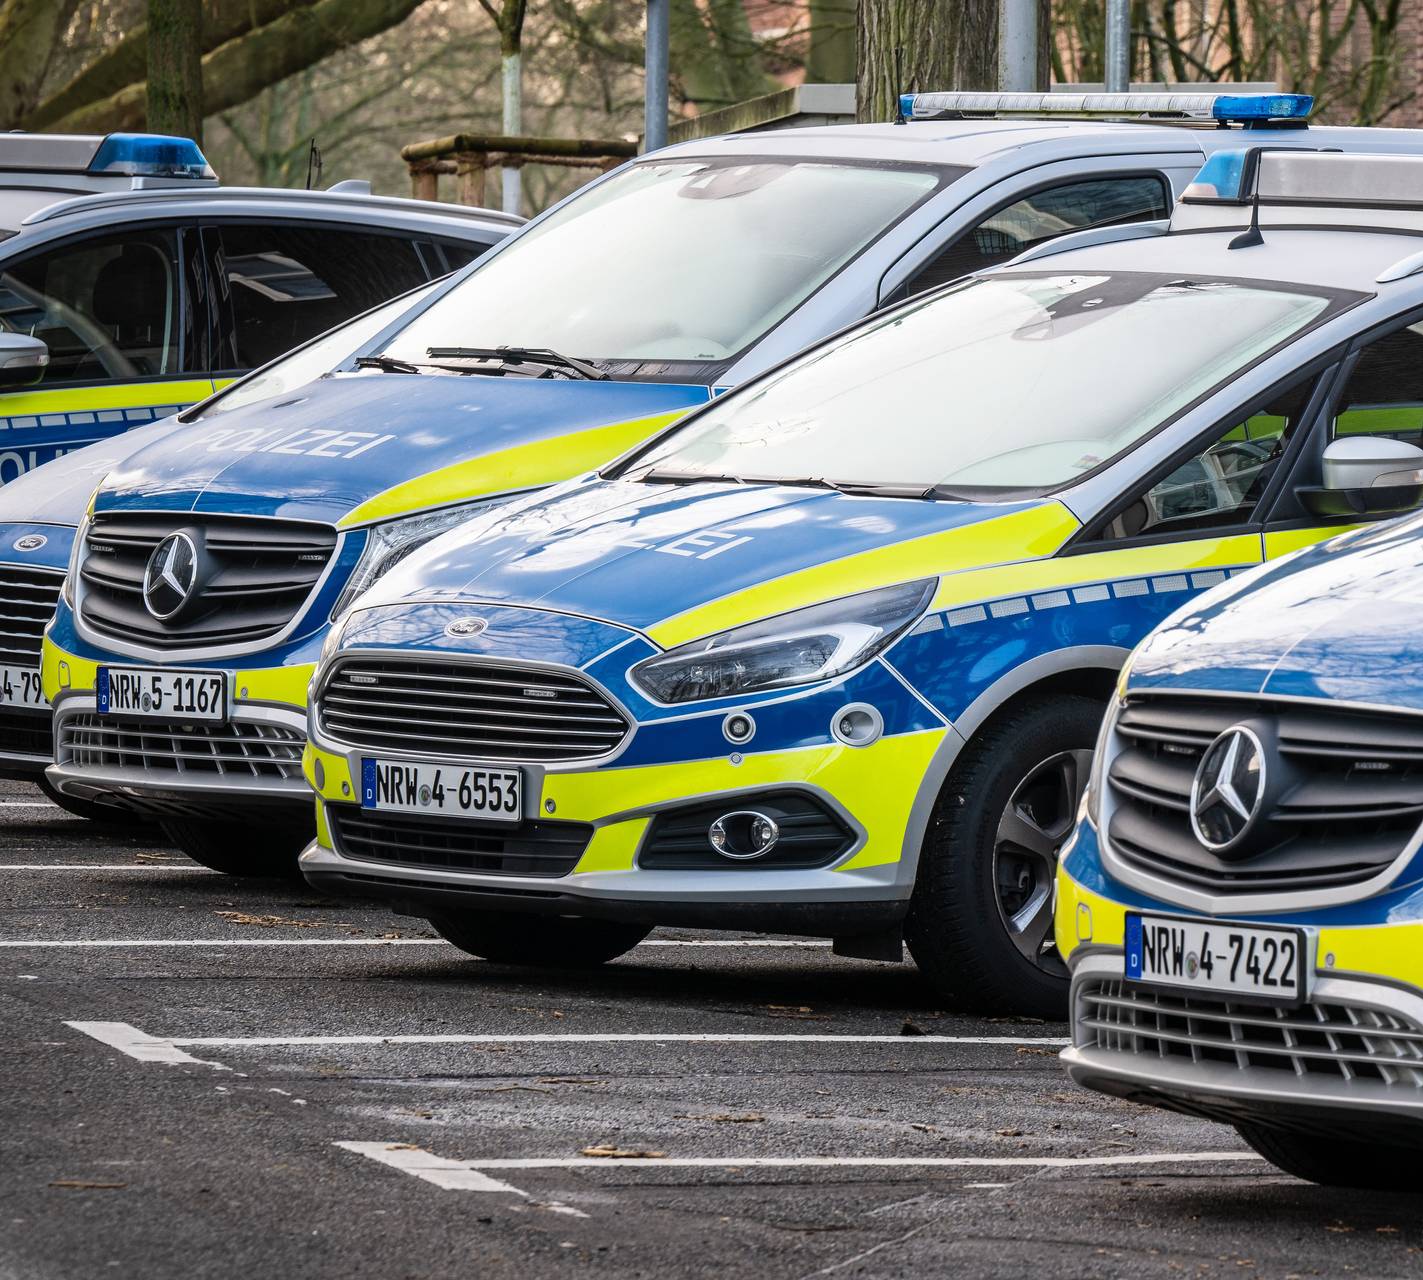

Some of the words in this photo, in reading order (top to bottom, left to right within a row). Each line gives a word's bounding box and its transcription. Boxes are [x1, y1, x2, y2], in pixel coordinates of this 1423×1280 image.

[178, 427, 396, 459] POLIZEI
[3, 670, 49, 704] 4-79
[109, 674, 140, 709] NRW
[152, 676, 221, 713] 5-1167
[366, 788, 373, 799] D
[376, 764, 418, 806] NRW
[432, 769, 518, 813] 4-6553
[1131, 954, 1138, 968] D
[1142, 924, 1184, 977] NRW
[1200, 931, 1295, 988] 4-7422
